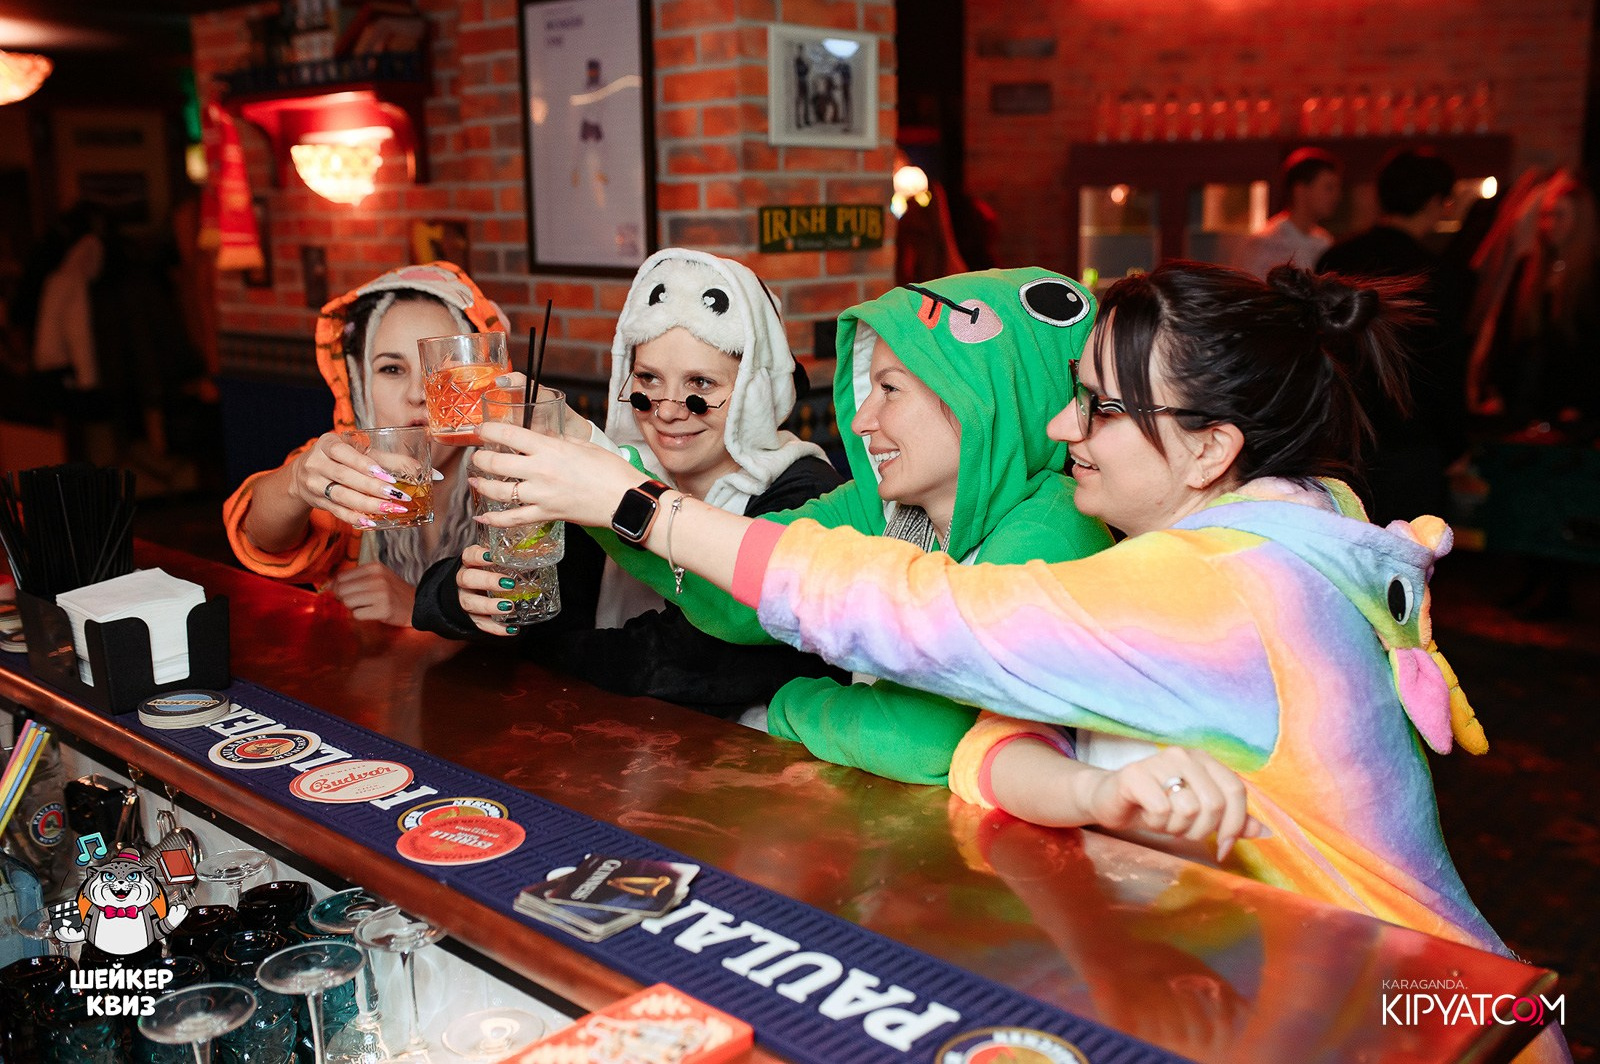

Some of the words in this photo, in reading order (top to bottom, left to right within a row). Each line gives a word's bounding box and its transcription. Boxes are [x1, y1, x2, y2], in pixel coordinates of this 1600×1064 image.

[762, 207, 827, 245] IRISH
[835, 206, 883, 241] PUB
[222, 734, 268, 762] PAULANER
[309, 766, 396, 793] Budvar
[429, 830, 494, 850] ESTRELLA
